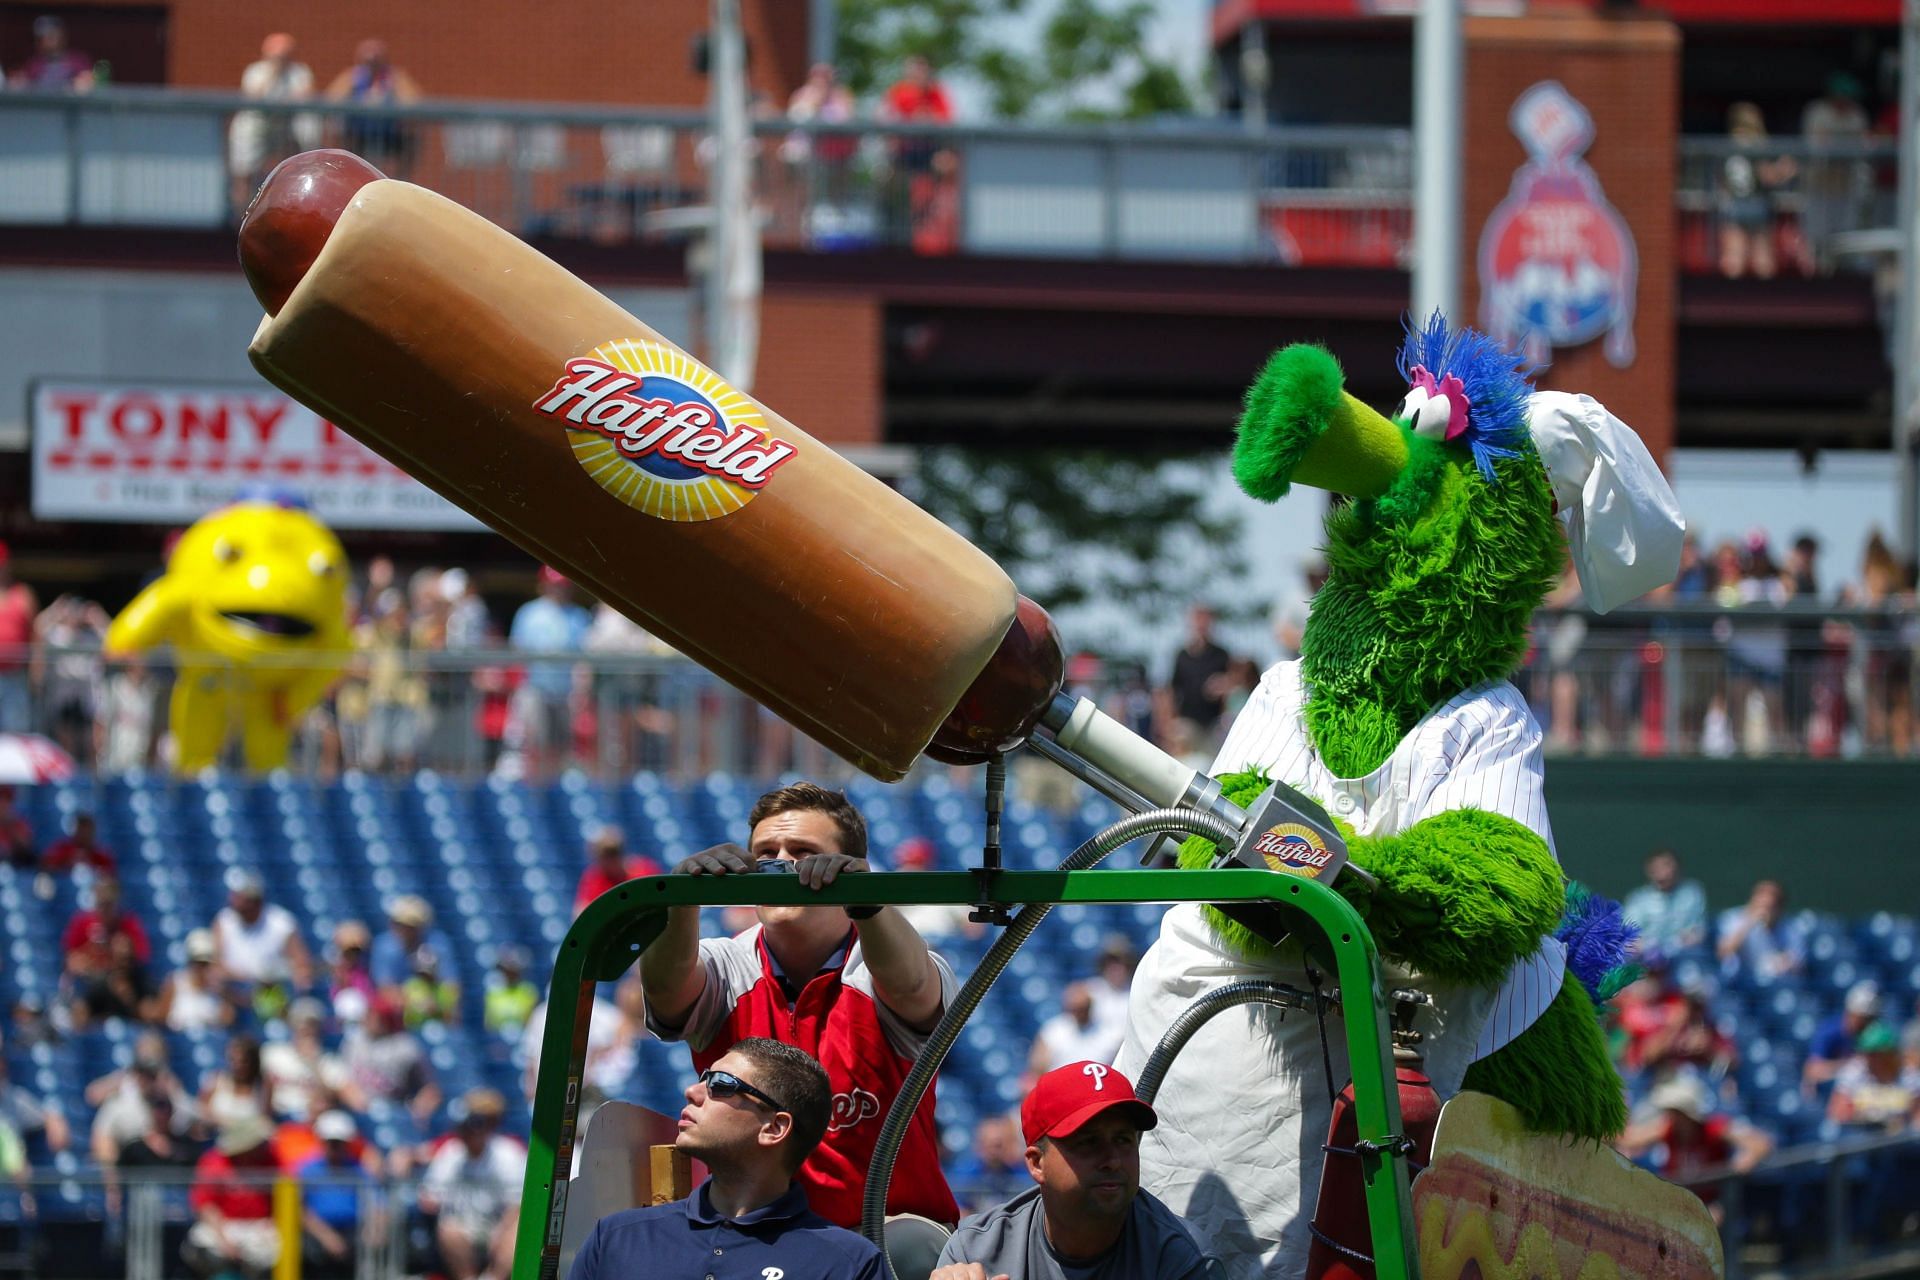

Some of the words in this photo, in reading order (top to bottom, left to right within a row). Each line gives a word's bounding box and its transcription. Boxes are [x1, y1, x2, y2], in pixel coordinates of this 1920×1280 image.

[52, 390, 291, 447] TONY
[537, 360, 796, 486] Hatfield
[1254, 833, 1333, 868] Hatfield
[1083, 1063, 1107, 1091] P
